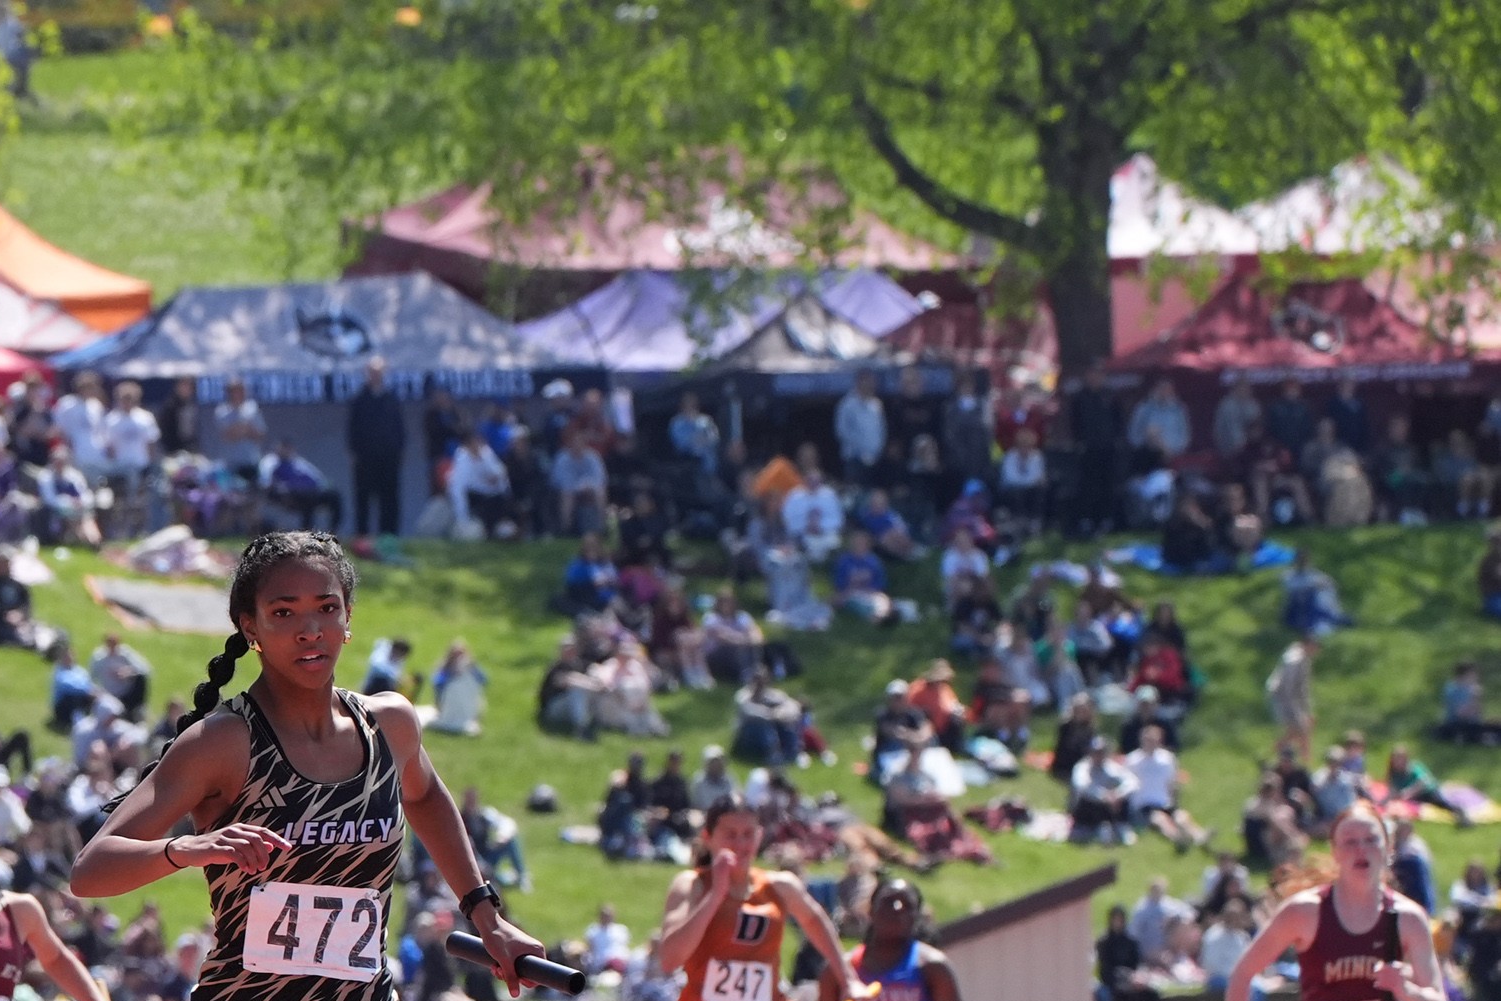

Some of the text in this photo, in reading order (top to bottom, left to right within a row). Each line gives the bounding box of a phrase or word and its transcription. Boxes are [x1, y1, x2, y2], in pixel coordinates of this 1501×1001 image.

[283, 817, 393, 847] LEGACY
[267, 893, 378, 969] 472
[732, 910, 771, 946] D
[714, 962, 765, 1001] 247
